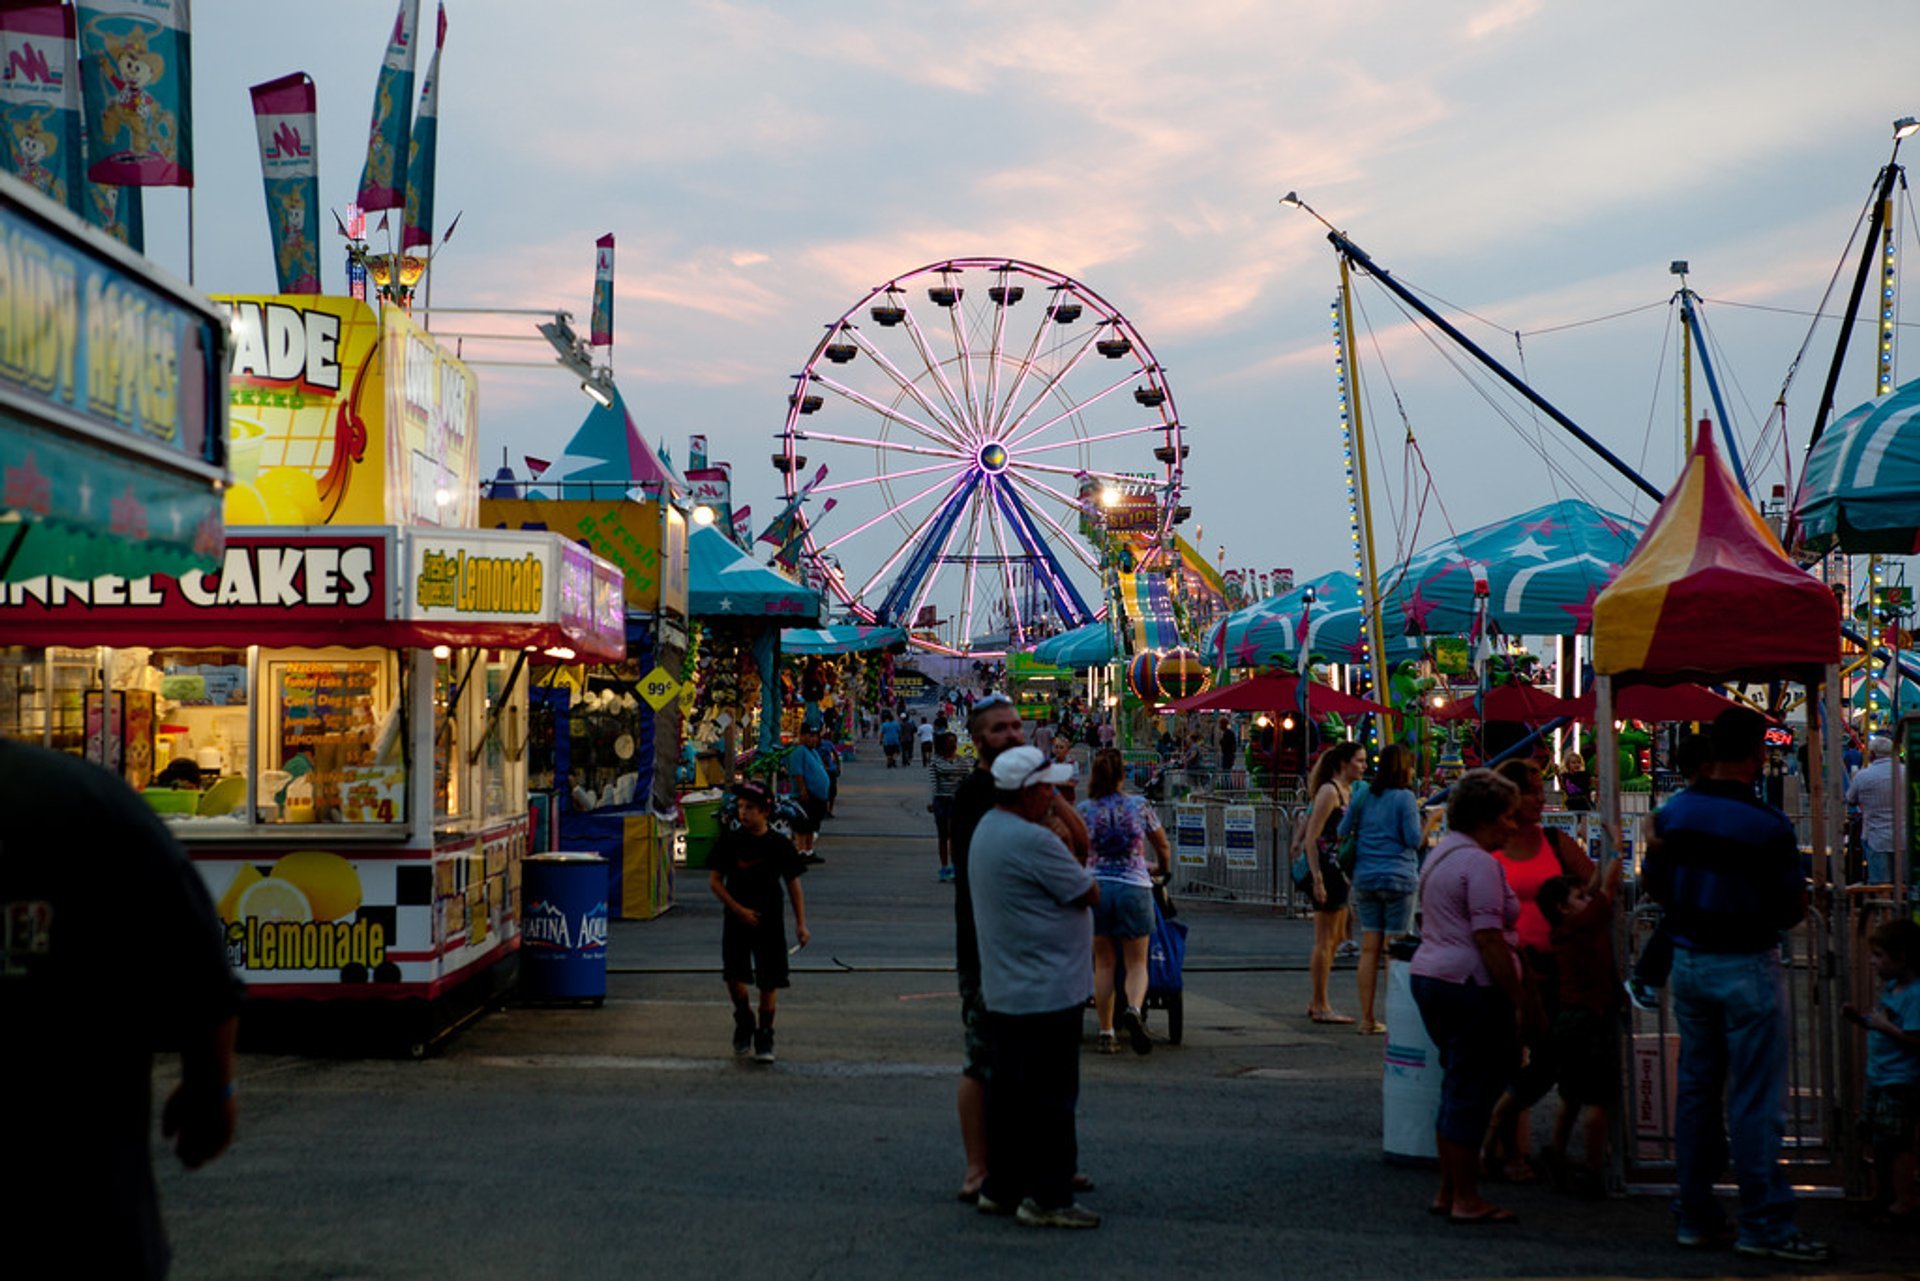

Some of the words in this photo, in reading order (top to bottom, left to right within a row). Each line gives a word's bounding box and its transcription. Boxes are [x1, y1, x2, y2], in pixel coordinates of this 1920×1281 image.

[225, 302, 340, 390] ADE
[179, 546, 372, 606] CAKES
[457, 549, 542, 613] Lemonade
[648, 681, 671, 695] 99¢
[246, 916, 385, 969] Lemonade
